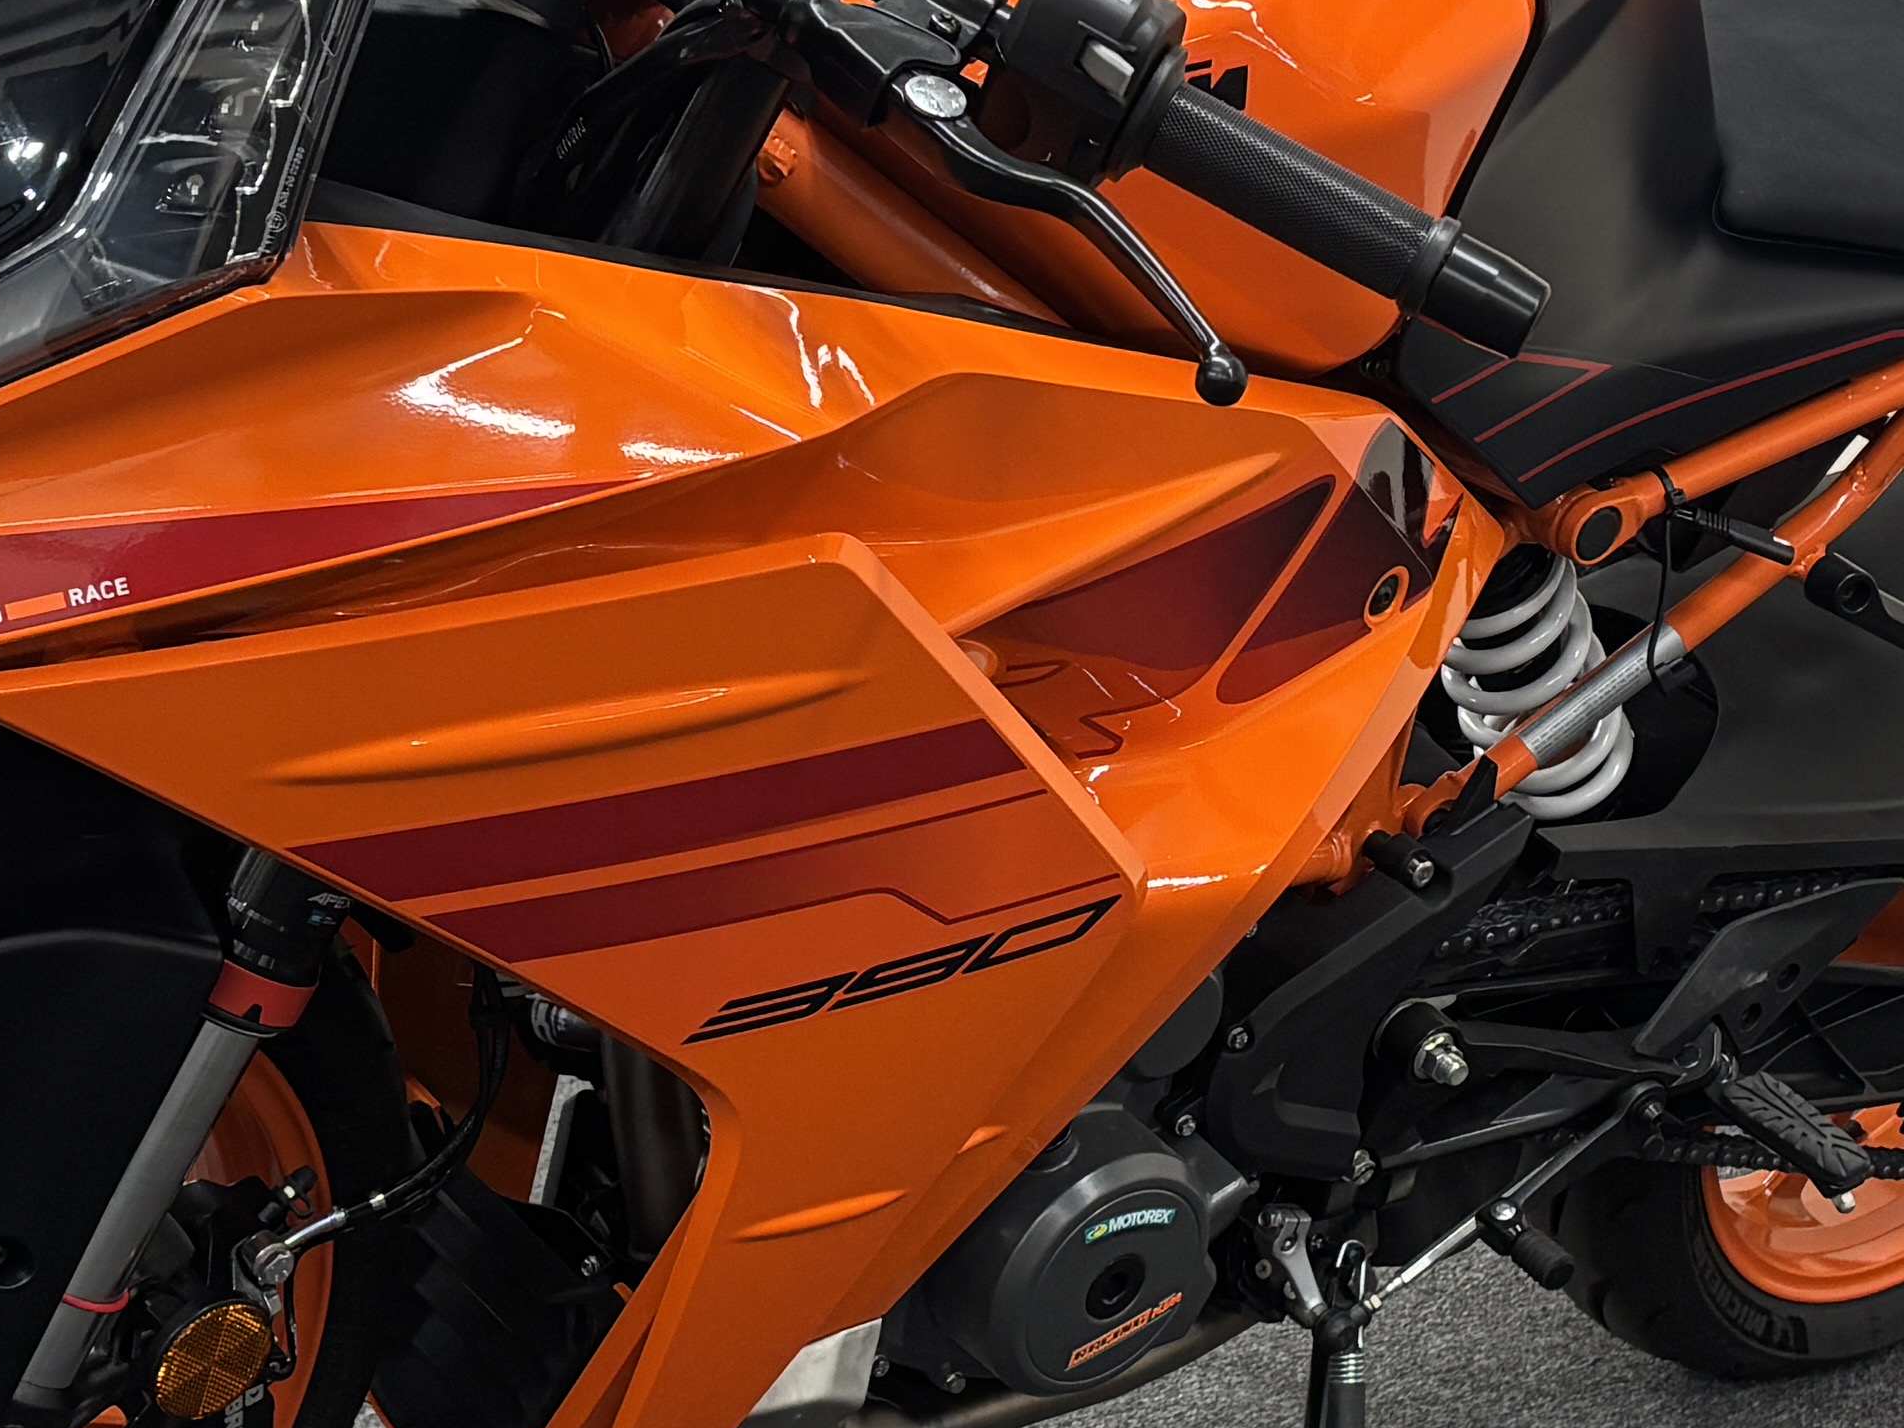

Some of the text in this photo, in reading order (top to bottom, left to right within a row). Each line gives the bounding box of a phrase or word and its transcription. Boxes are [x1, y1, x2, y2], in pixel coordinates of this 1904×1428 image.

[68, 577, 130, 607] RACE
[681, 894, 1122, 1045] 390
[1109, 1209, 1172, 1233] MOTOREX
